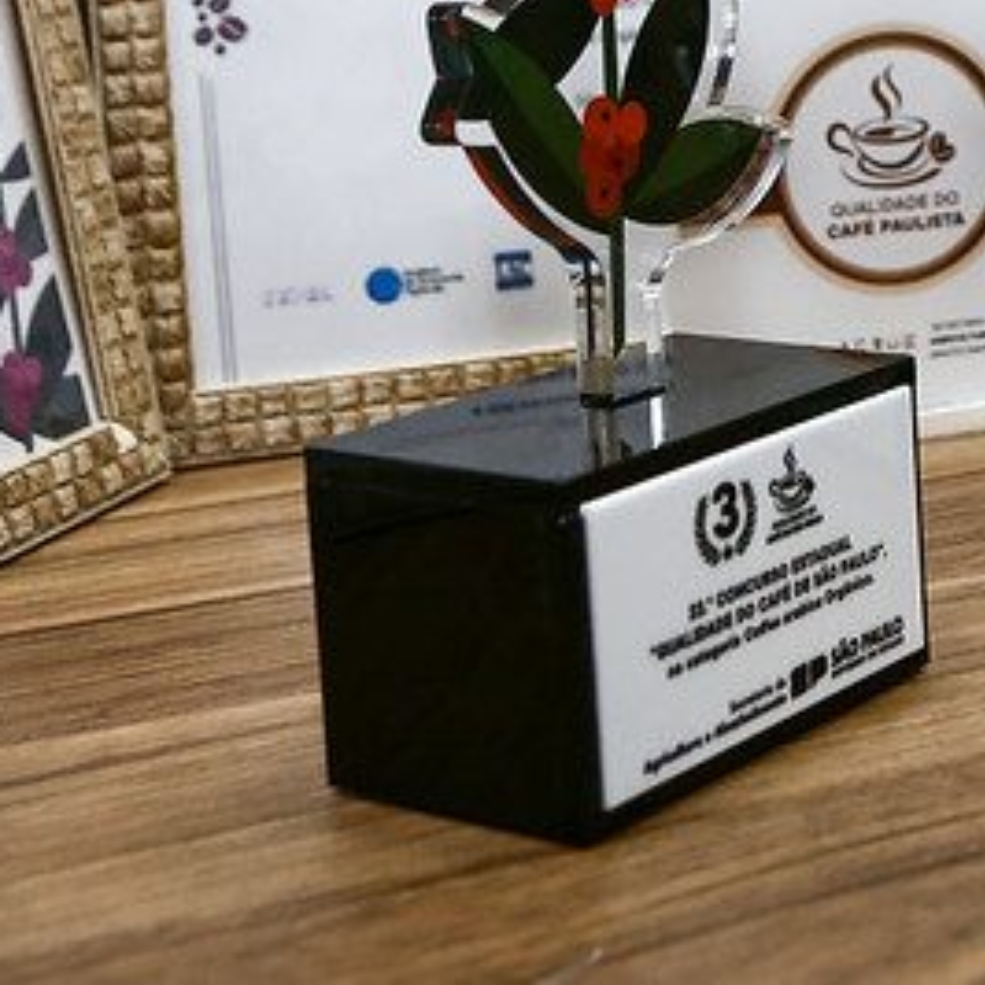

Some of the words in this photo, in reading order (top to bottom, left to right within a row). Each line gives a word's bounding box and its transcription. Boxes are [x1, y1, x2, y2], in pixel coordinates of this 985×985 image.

[829, 193, 926, 218] QUALIDADE
[933, 188, 958, 208] DO
[826, 216, 873, 240] CAFÉ
[879, 210, 966, 234] PAULISTA
[712, 481, 741, 539] 3
[736, 603, 755, 623] DO
[758, 581, 791, 613] CAFÉ
